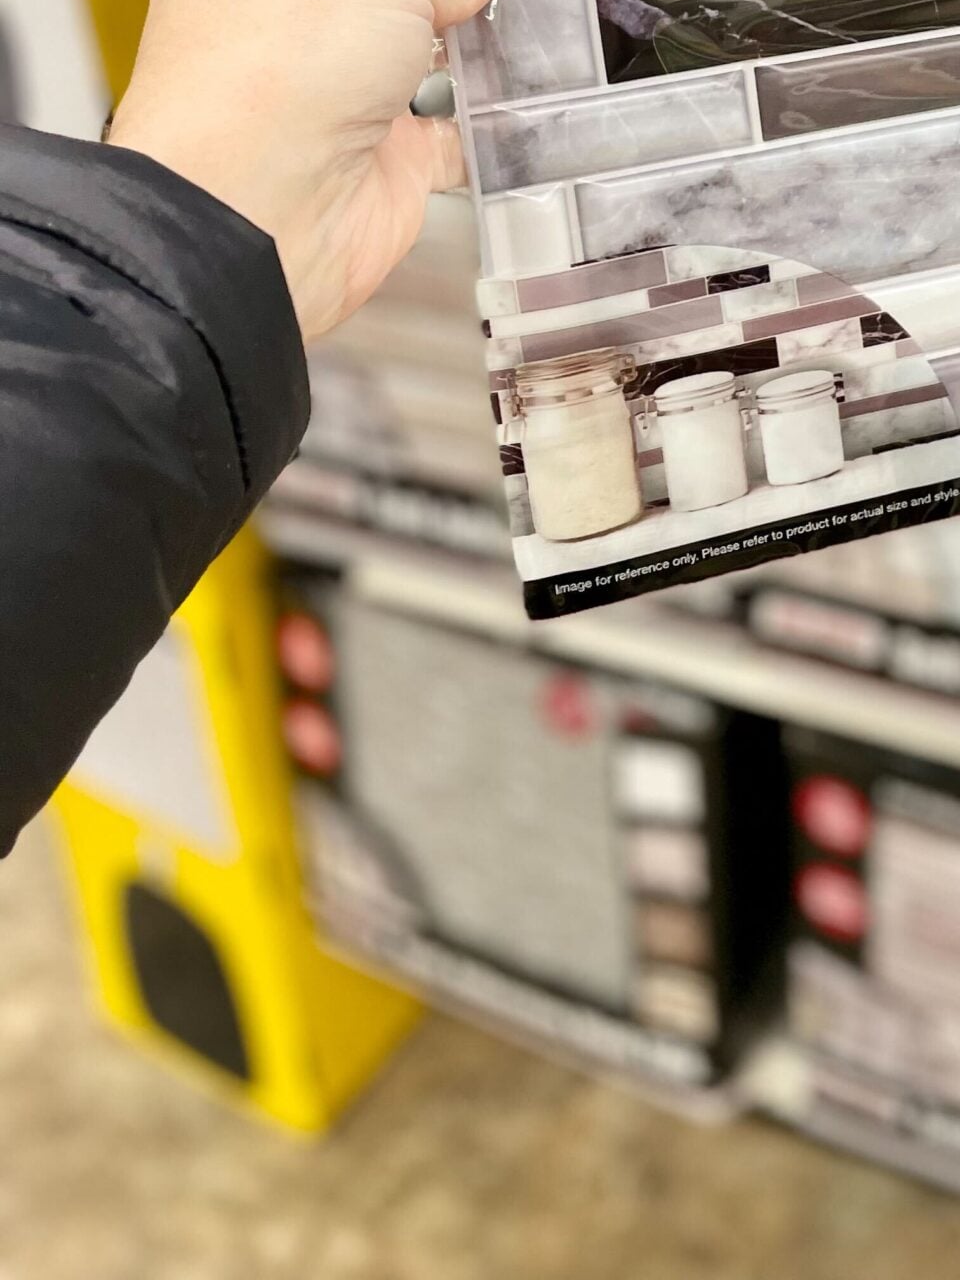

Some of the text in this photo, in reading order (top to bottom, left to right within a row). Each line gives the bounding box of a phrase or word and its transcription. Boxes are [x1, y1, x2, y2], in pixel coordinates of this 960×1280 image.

[555, 580, 592, 596] Image
[595, 574, 613, 587] for
[615, 560, 670, 582] reference
[672, 553, 699, 568] only.
[701, 543, 740, 559] Please
[743, 535, 769, 549] refer
[771, 531, 783, 542] to
[786, 519, 829, 540] product
[832, 513, 848, 526] for
[850, 505, 884, 522] actual
[886, 499, 908, 513] size
[910, 494, 932, 508] and
